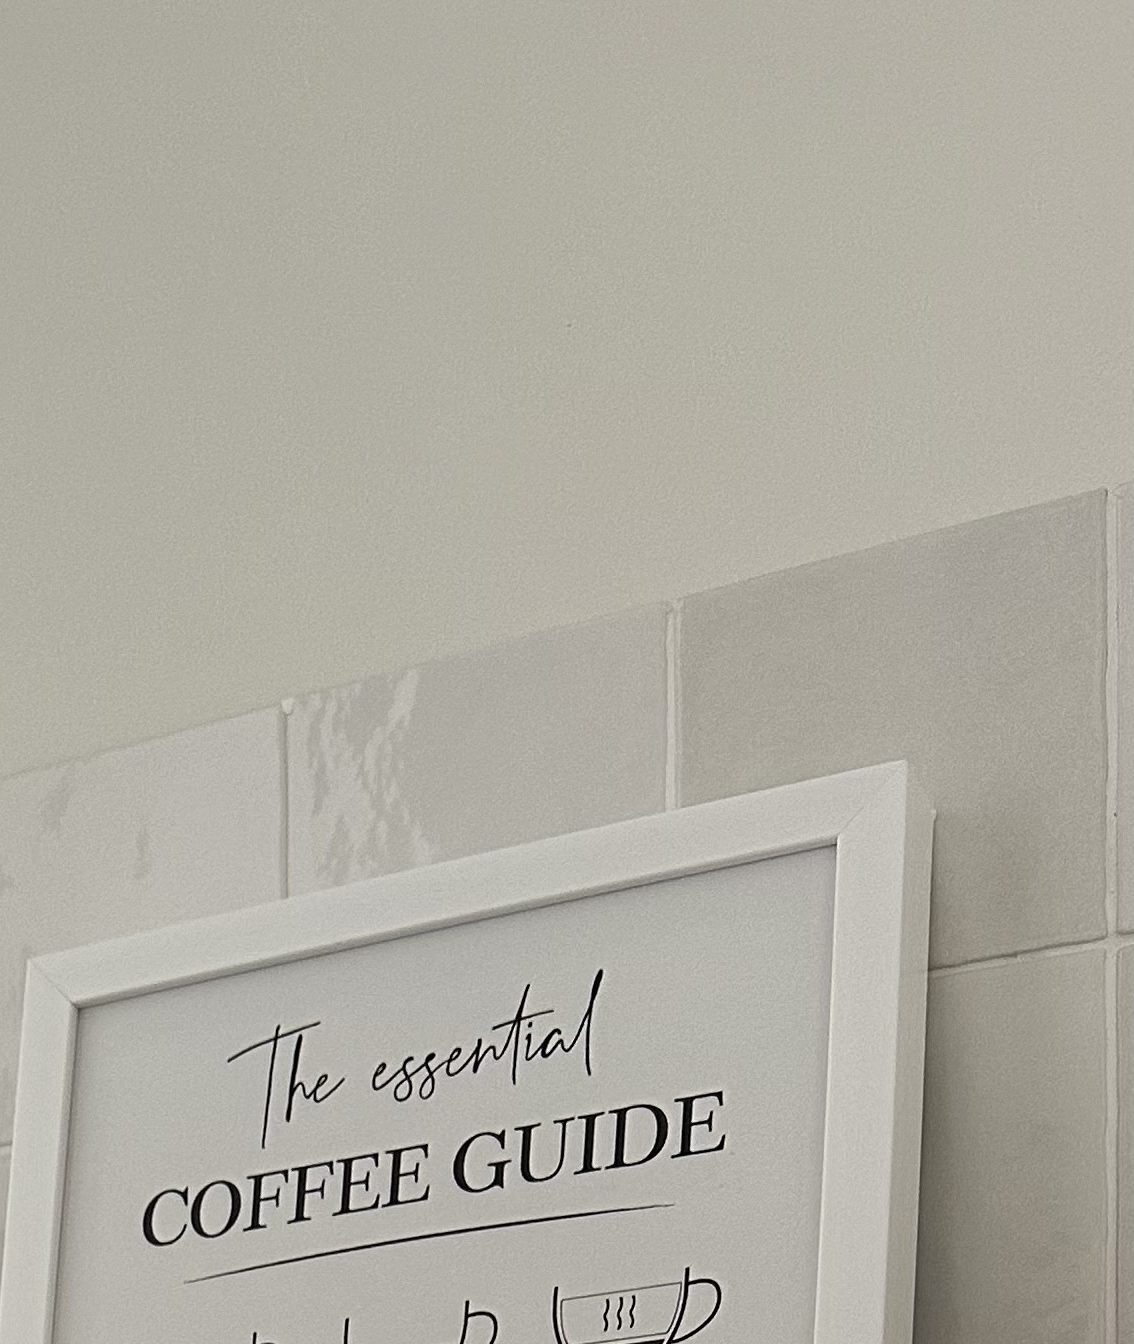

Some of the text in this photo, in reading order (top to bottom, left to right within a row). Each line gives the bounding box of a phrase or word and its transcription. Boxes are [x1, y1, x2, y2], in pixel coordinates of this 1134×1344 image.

[227, 969, 603, 1149] The essential
[143, 1091, 725, 1247] COFFEE GUIDE
